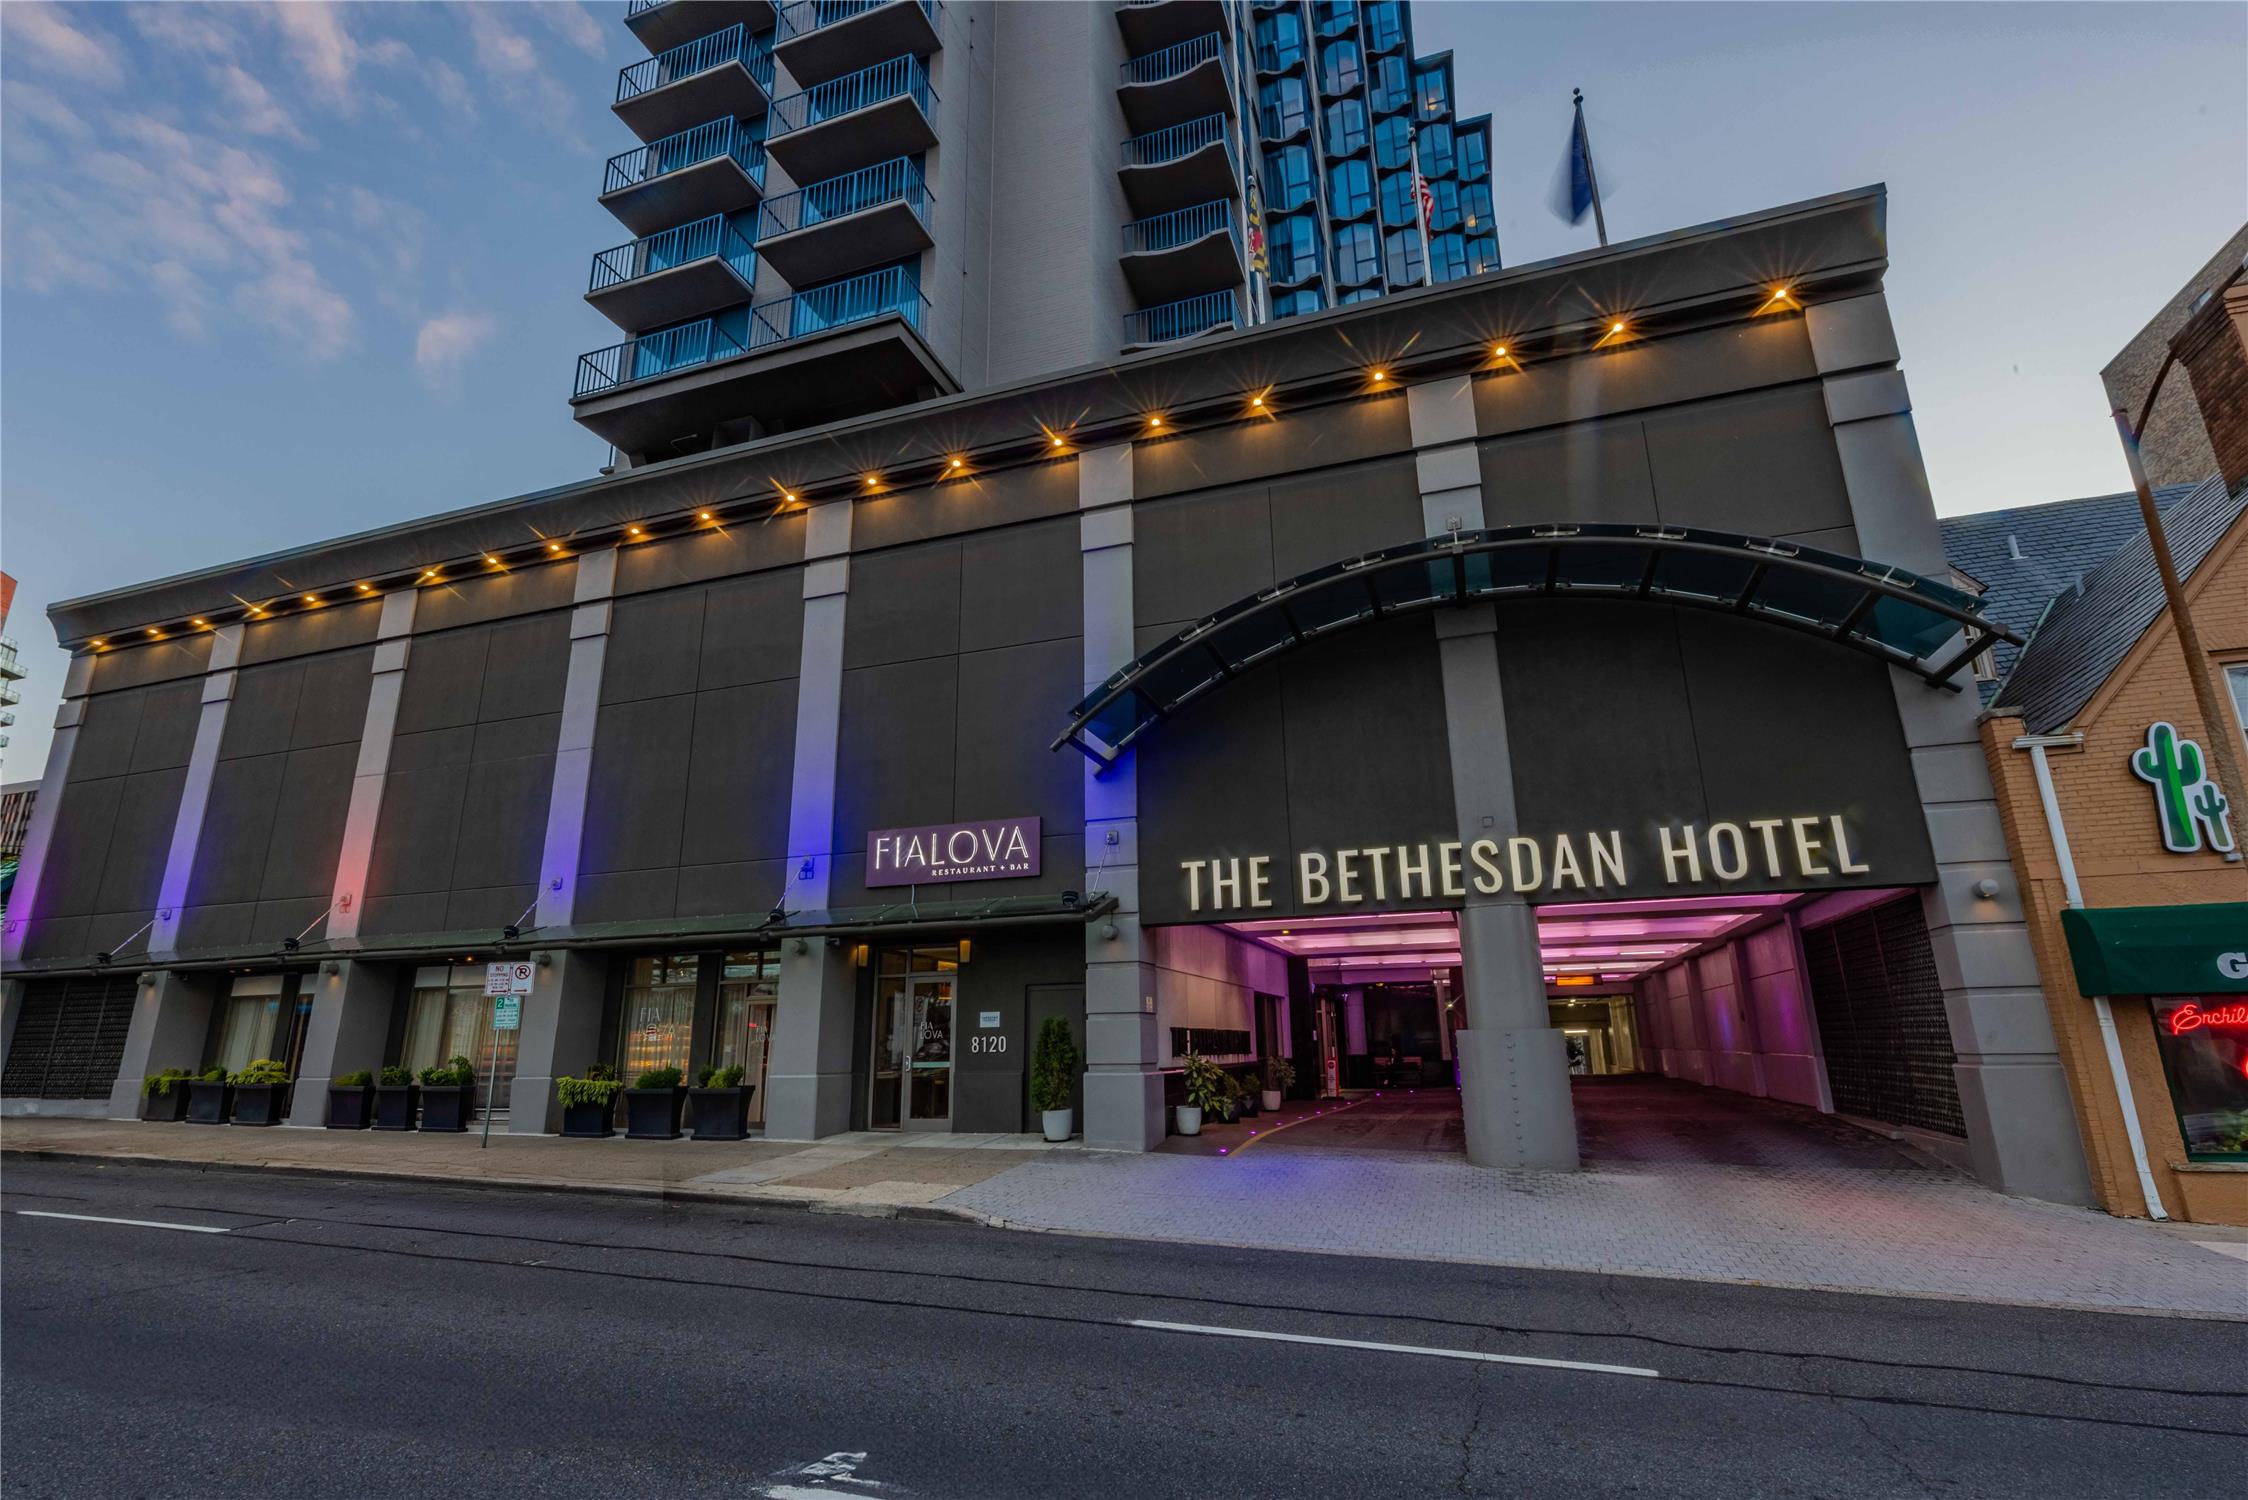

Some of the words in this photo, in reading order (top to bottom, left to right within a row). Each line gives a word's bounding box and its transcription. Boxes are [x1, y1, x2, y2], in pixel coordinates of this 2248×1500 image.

[875, 825, 1029, 870] FIALOVA
[931, 865, 996, 876] RESTAURANT
[1009, 863, 1029, 871] BAR
[1180, 855, 1273, 911] THE
[1299, 829, 1627, 905] BETHESDAN
[1657, 814, 1870, 884] HOTEL
[497, 998, 504, 1008] 2
[920, 1021, 934, 1030] FIA
[2172, 1004, 2248, 1036] Enchil
[920, 1030, 944, 1040] LOVA
[971, 1035, 1007, 1053] 8120
